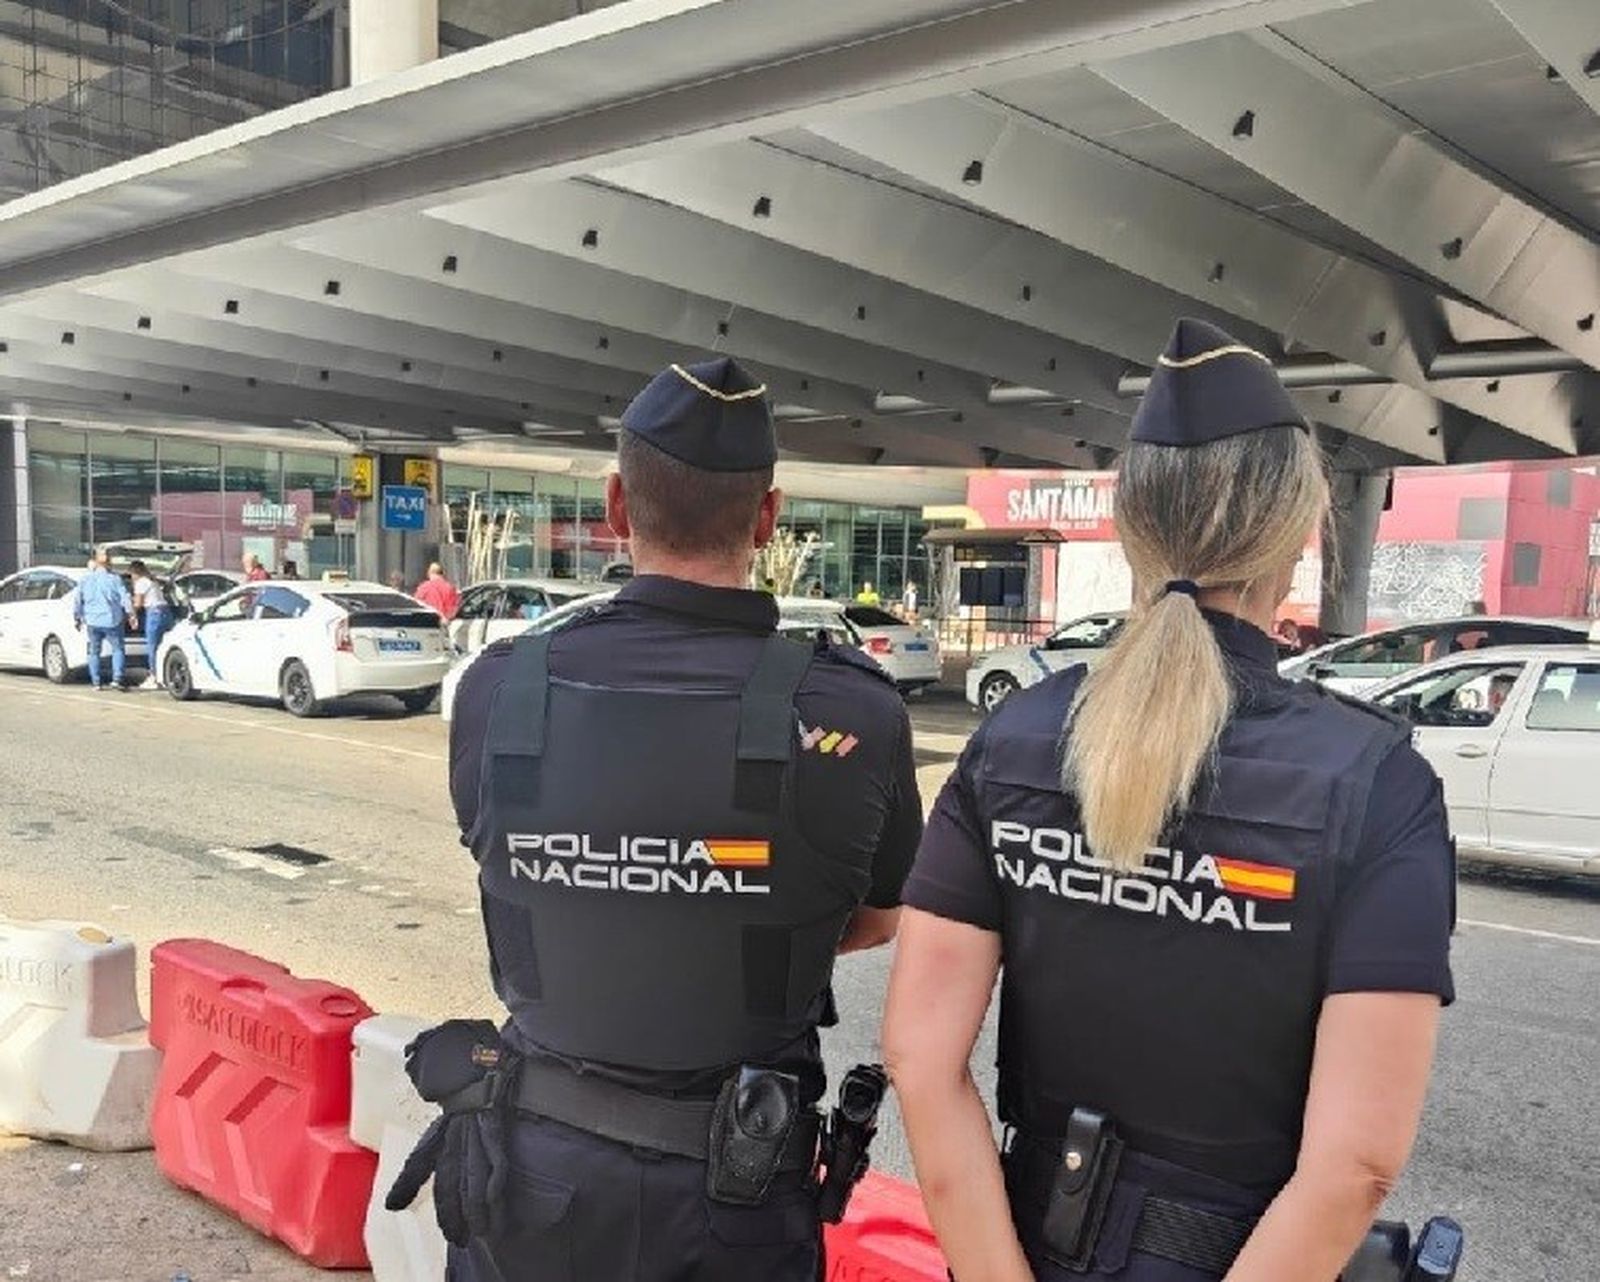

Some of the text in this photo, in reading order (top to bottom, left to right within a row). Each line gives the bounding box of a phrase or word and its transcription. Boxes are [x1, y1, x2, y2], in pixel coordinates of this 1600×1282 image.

[385, 495, 425, 511] TAXI
[507, 832, 715, 865] POLICIA
[991, 820, 1225, 889] POLCIA
[509, 857, 771, 894] NACIONAL
[994, 853, 1292, 932] NACIONAL
